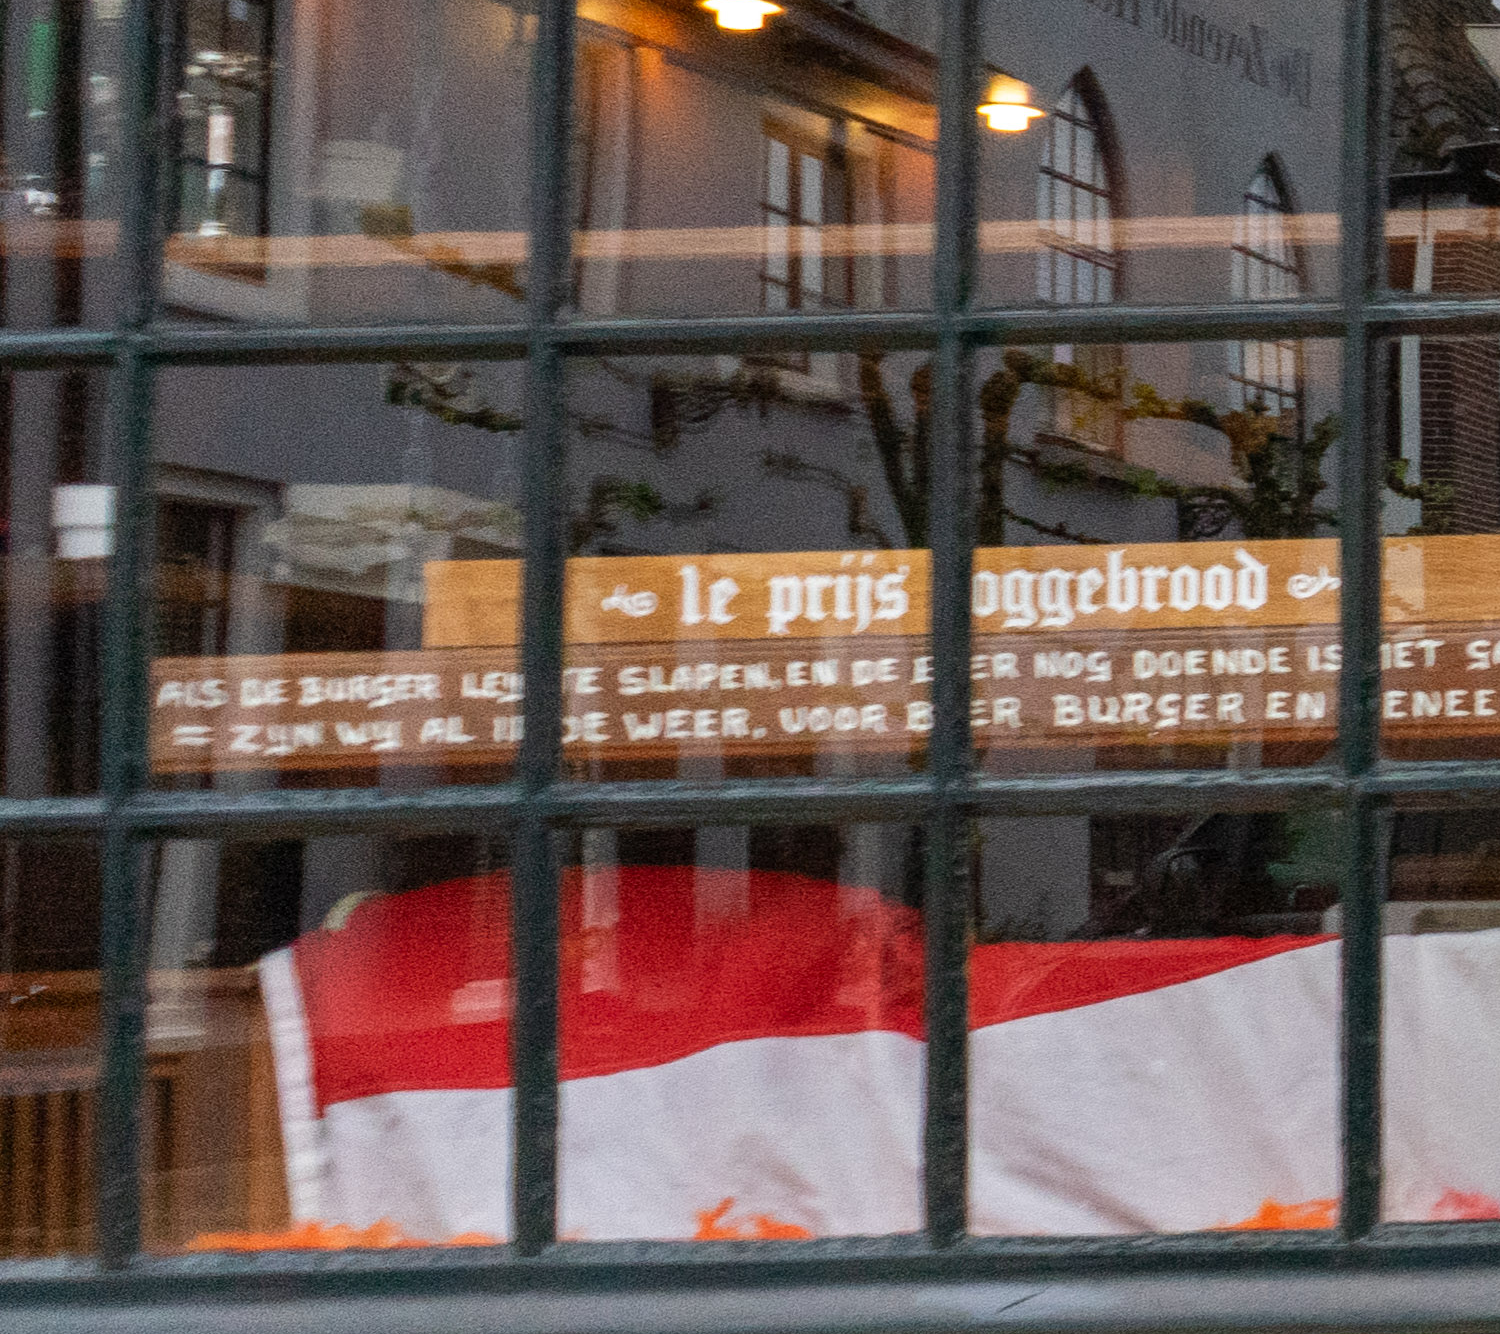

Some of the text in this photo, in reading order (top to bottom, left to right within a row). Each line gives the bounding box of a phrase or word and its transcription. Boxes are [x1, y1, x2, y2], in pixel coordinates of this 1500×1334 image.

[765, 553, 911, 635] prijs
[972, 548, 1268, 628] oggebrood
[156, 677, 230, 709] ALS
[239, 678, 291, 707] DE
[852, 657, 900, 685] DE
[1033, 649, 1112, 682] NOG
[1133, 646, 1292, 679] DOENDE
[419, 715, 479, 744] AL
[779, 703, 888, 735] VOOR
[906, 695, 1022, 731] BER
[1053, 691, 1245, 730] BURGER
[1265, 690, 1327, 720] EN
